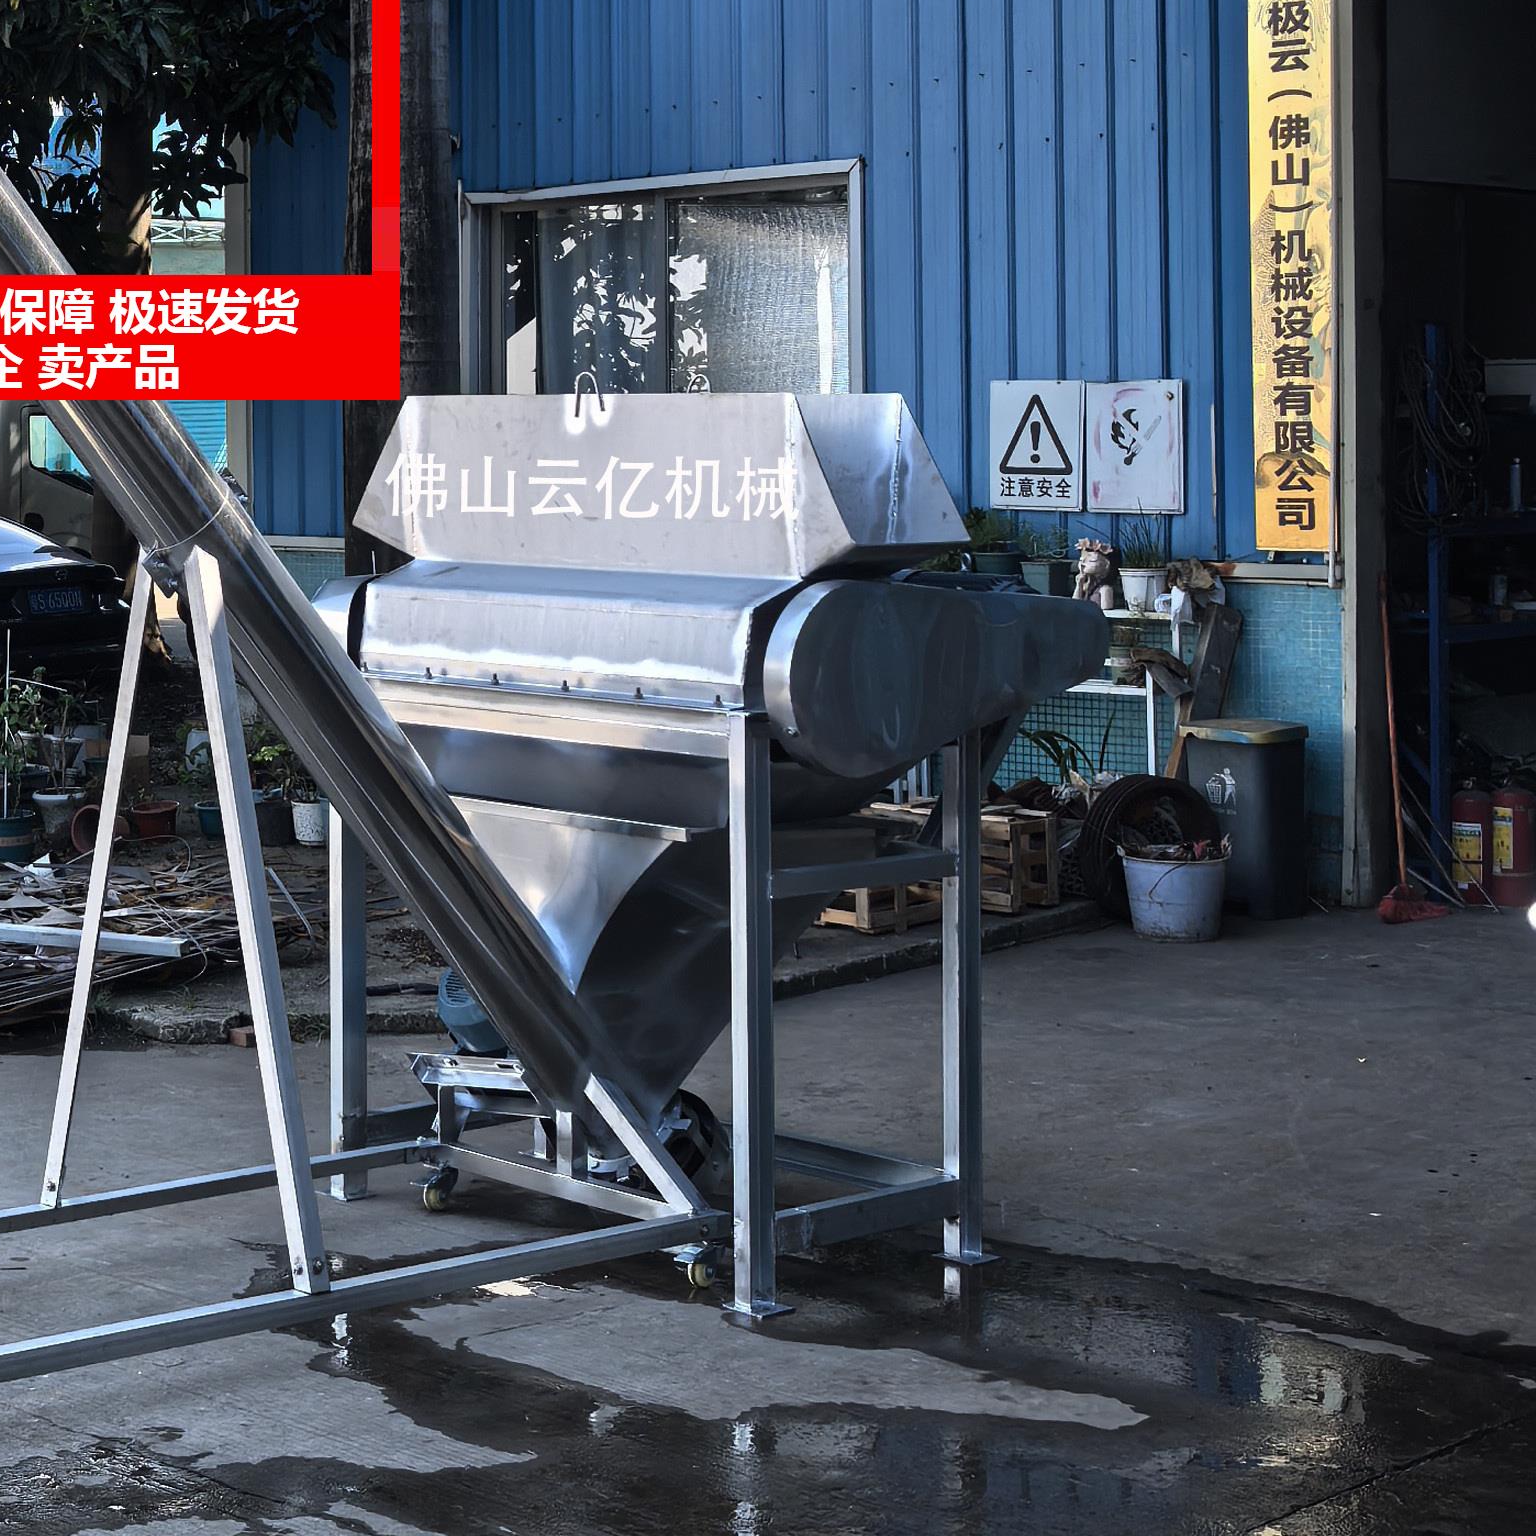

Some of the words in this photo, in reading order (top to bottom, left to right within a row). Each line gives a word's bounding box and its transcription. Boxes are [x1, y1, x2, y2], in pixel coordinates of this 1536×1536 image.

[1267, 0, 1317, 531] 极云（佛山）机械设备有限公司
[1000, 477, 1072, 499] 注意安全
